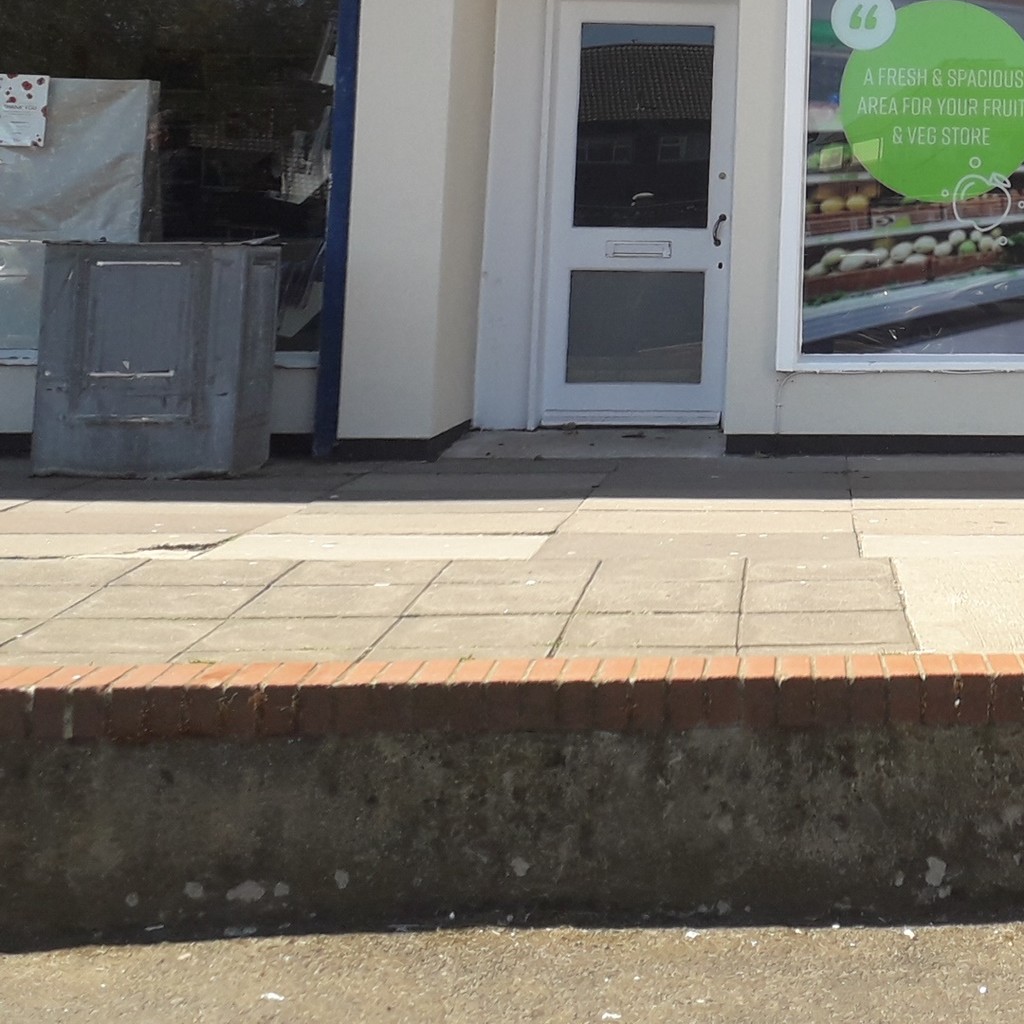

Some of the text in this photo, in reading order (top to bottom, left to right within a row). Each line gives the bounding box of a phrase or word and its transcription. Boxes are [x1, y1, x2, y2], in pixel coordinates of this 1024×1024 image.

[863, 67, 1024, 88] A FRESH & SPACIOUS
[857, 96, 898, 115] AREA
[903, 97, 932, 115] FOR
[938, 98, 978, 116] YOUR
[892, 126, 991, 146] & VEG STORE
